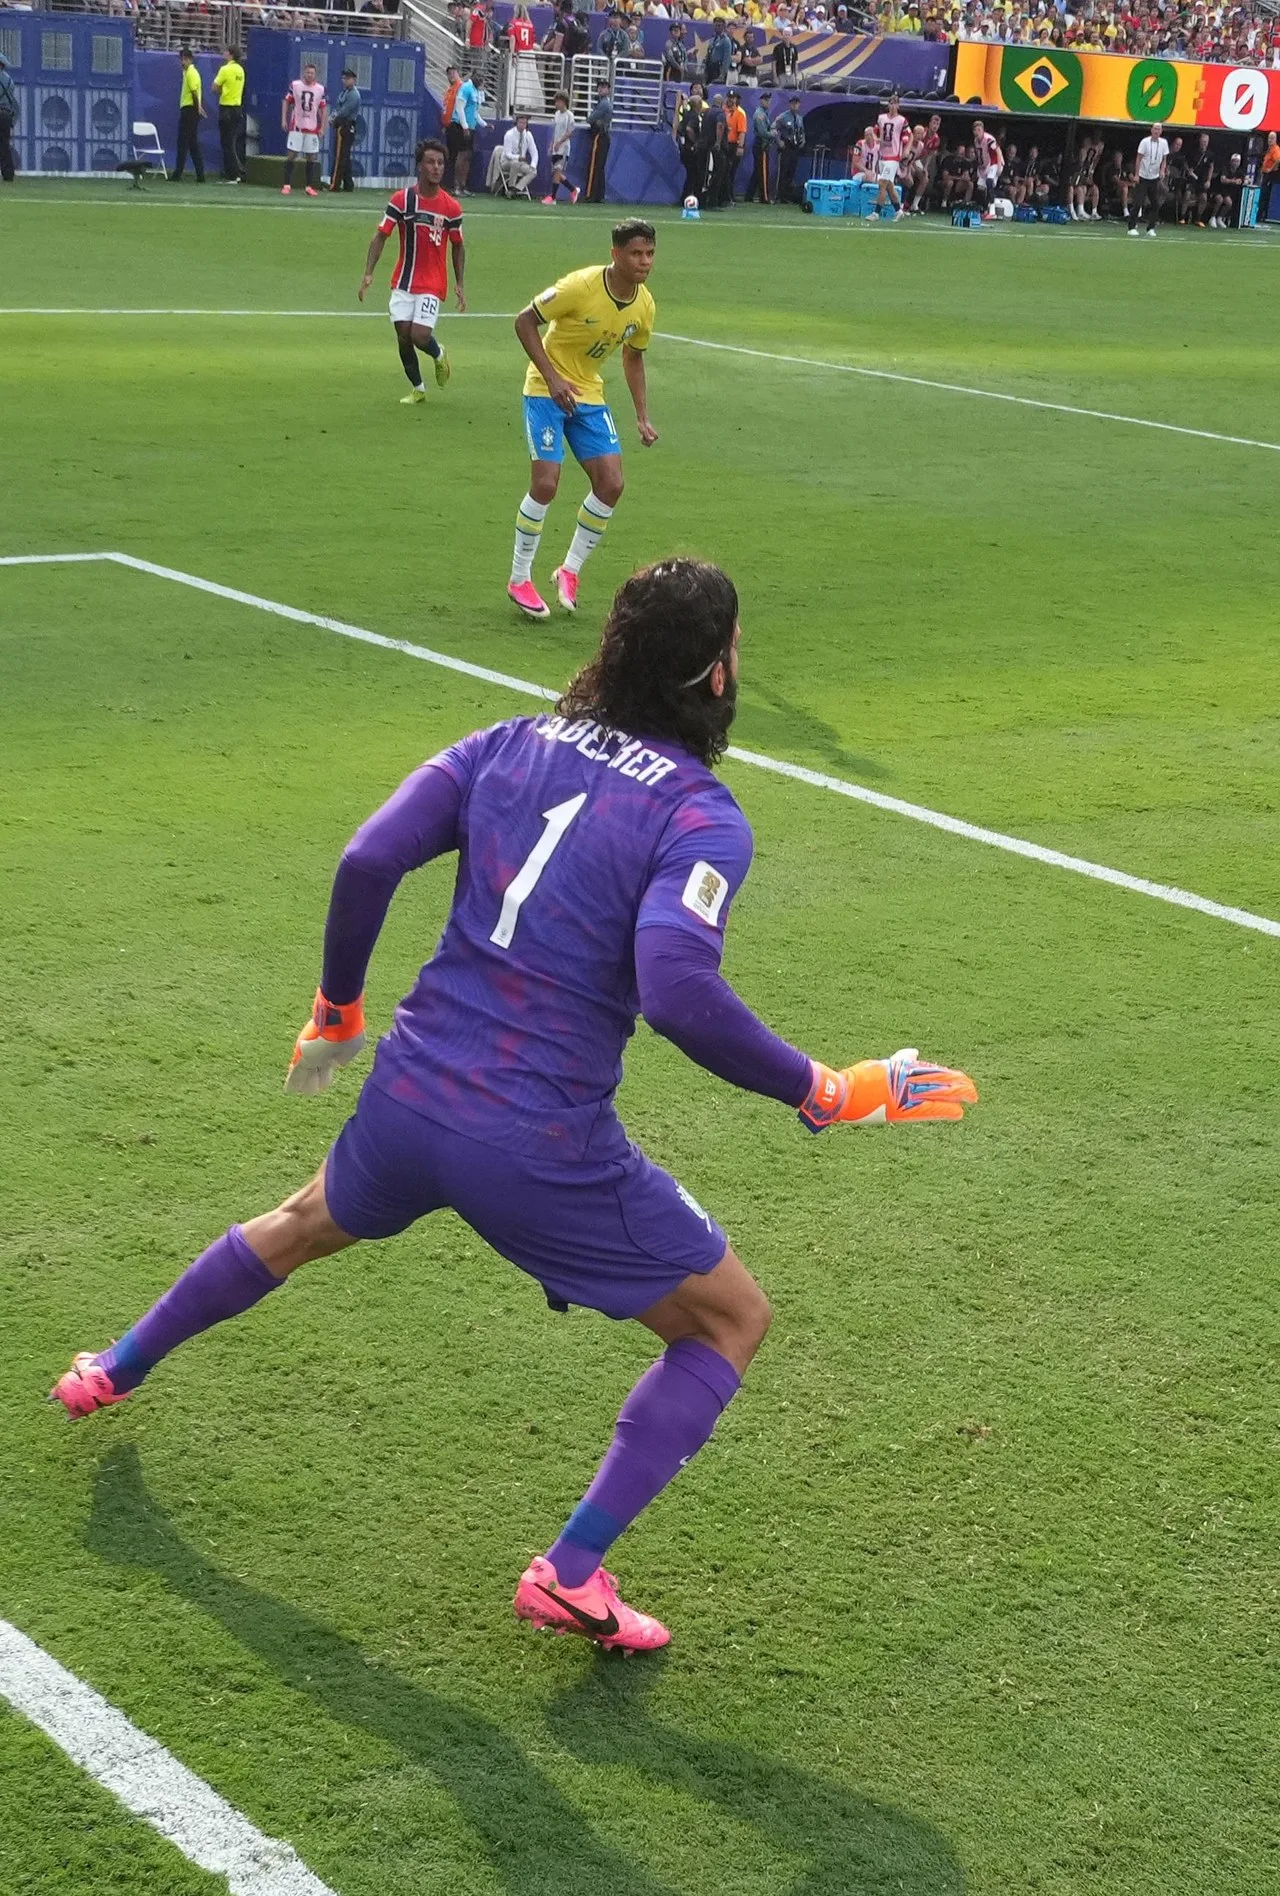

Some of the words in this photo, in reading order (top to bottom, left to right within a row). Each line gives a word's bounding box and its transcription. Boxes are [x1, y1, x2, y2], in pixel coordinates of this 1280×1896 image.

[421, 297, 437, 315] 22
[586, 340, 610, 358] 16
[489, 793, 588, 950] 1
